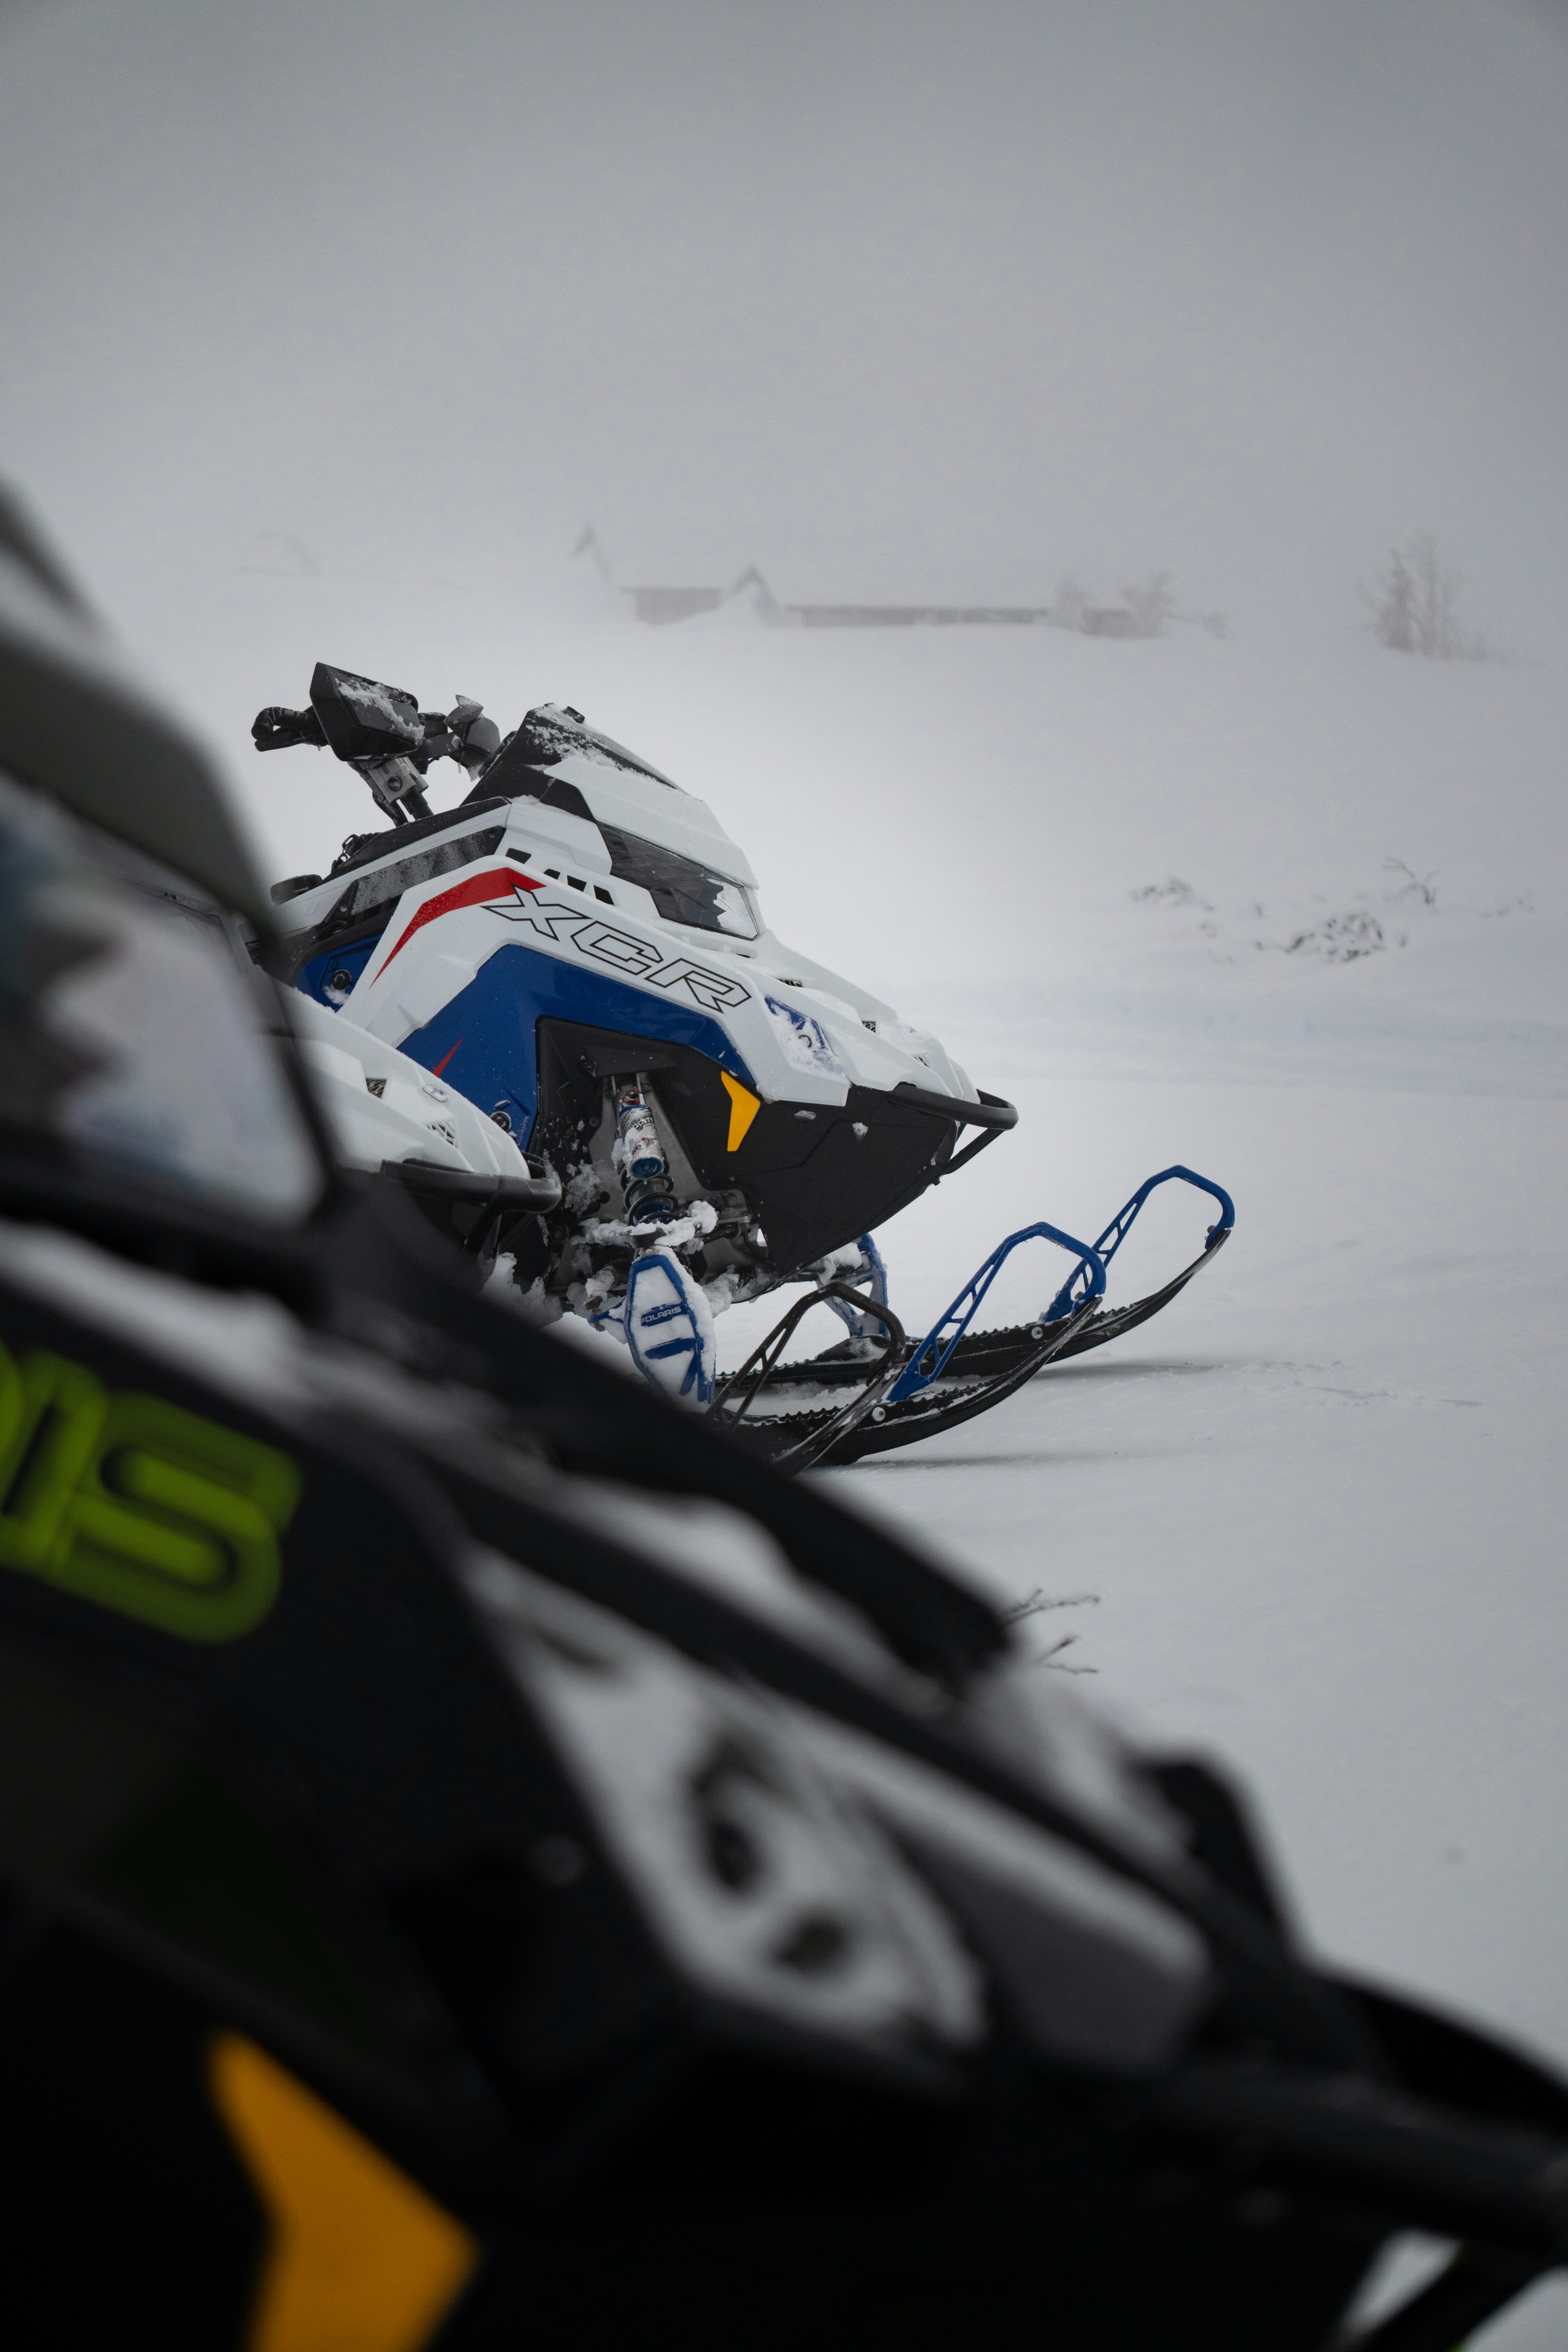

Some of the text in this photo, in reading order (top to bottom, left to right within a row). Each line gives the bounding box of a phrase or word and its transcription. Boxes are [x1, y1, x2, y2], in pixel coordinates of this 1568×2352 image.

[480, 882, 752, 1013] XCR
[640, 1306, 682, 1324] POLARIS
[0, 1339, 303, 1644] IS
